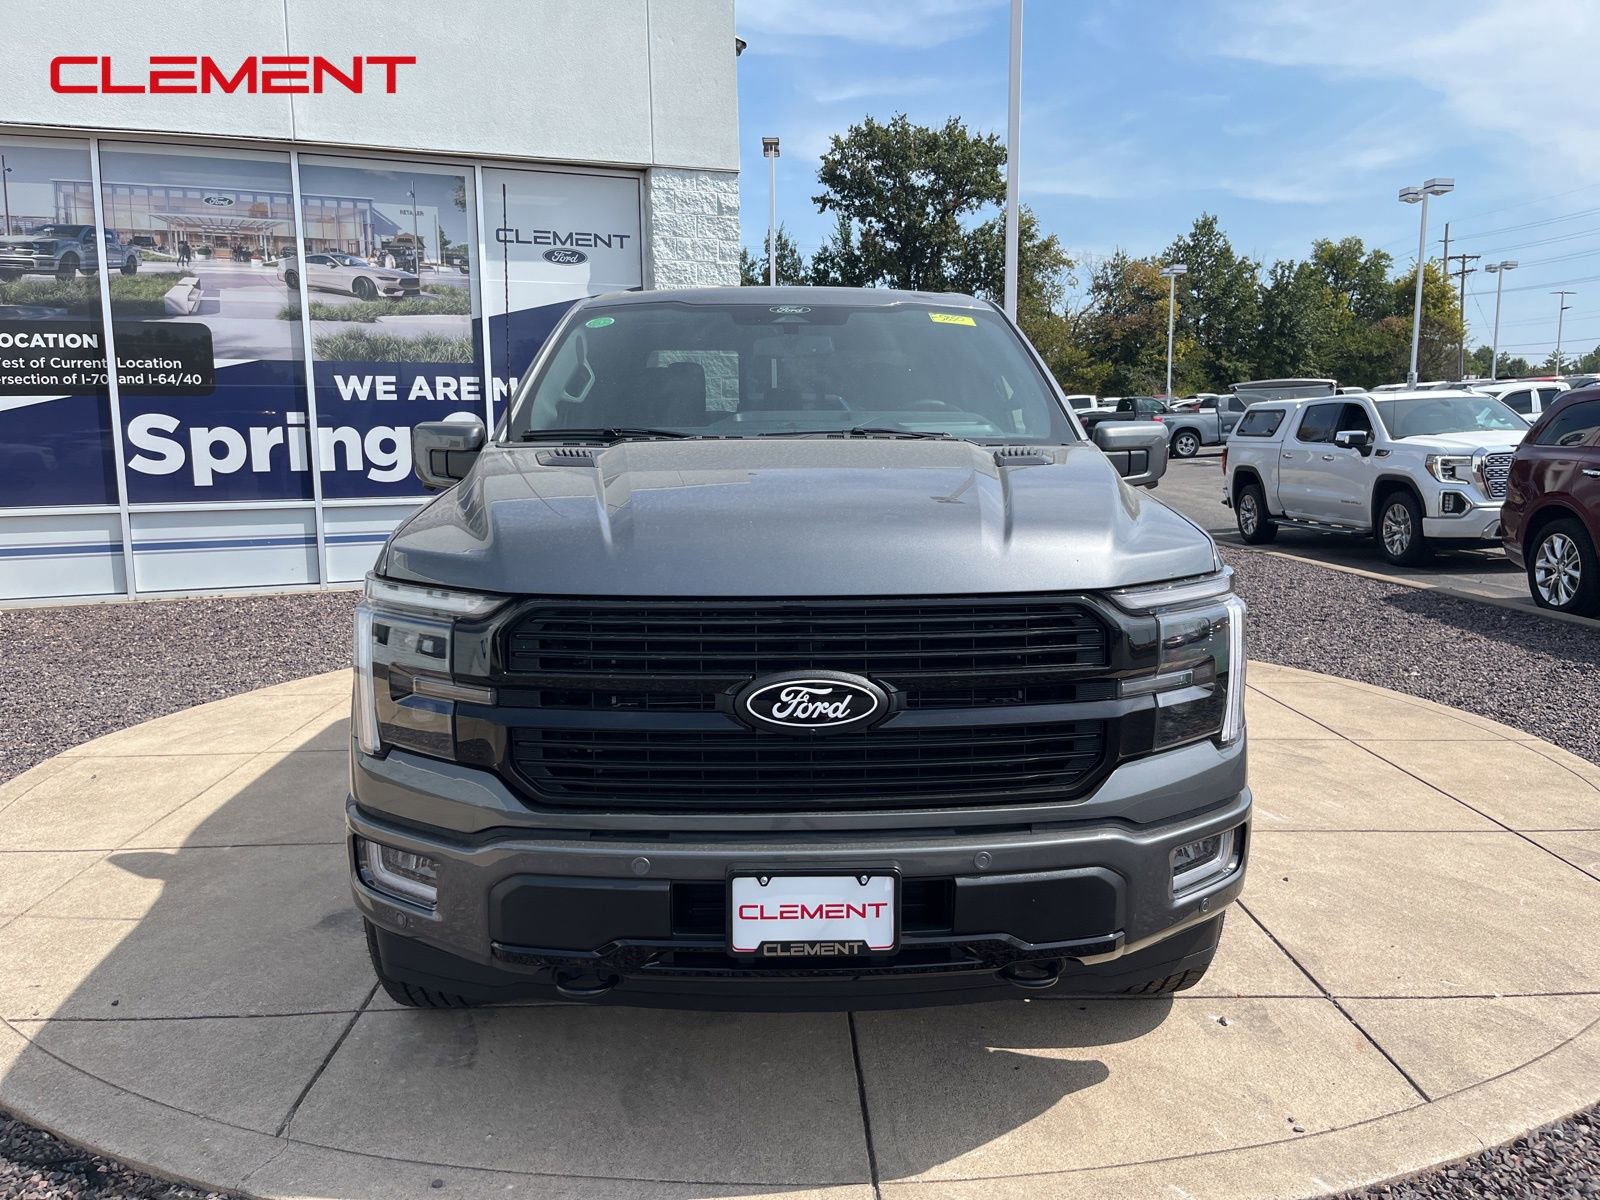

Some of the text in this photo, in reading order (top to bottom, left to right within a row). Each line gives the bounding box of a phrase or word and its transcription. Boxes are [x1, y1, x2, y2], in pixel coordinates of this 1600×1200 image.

[496, 228, 630, 249] CLEMENT
[0, 357, 182, 369] est of Current Location
[0, 373, 202, 386] rsection of I-70 and I-64/40
[334, 375, 398, 401] WE
[408, 376, 481, 401] ARE
[127, 411, 413, 487] Spring
[772, 686, 852, 719] Ford
[738, 902, 889, 921] CLEMENT
[763, 941, 864, 957] CLEMENT
